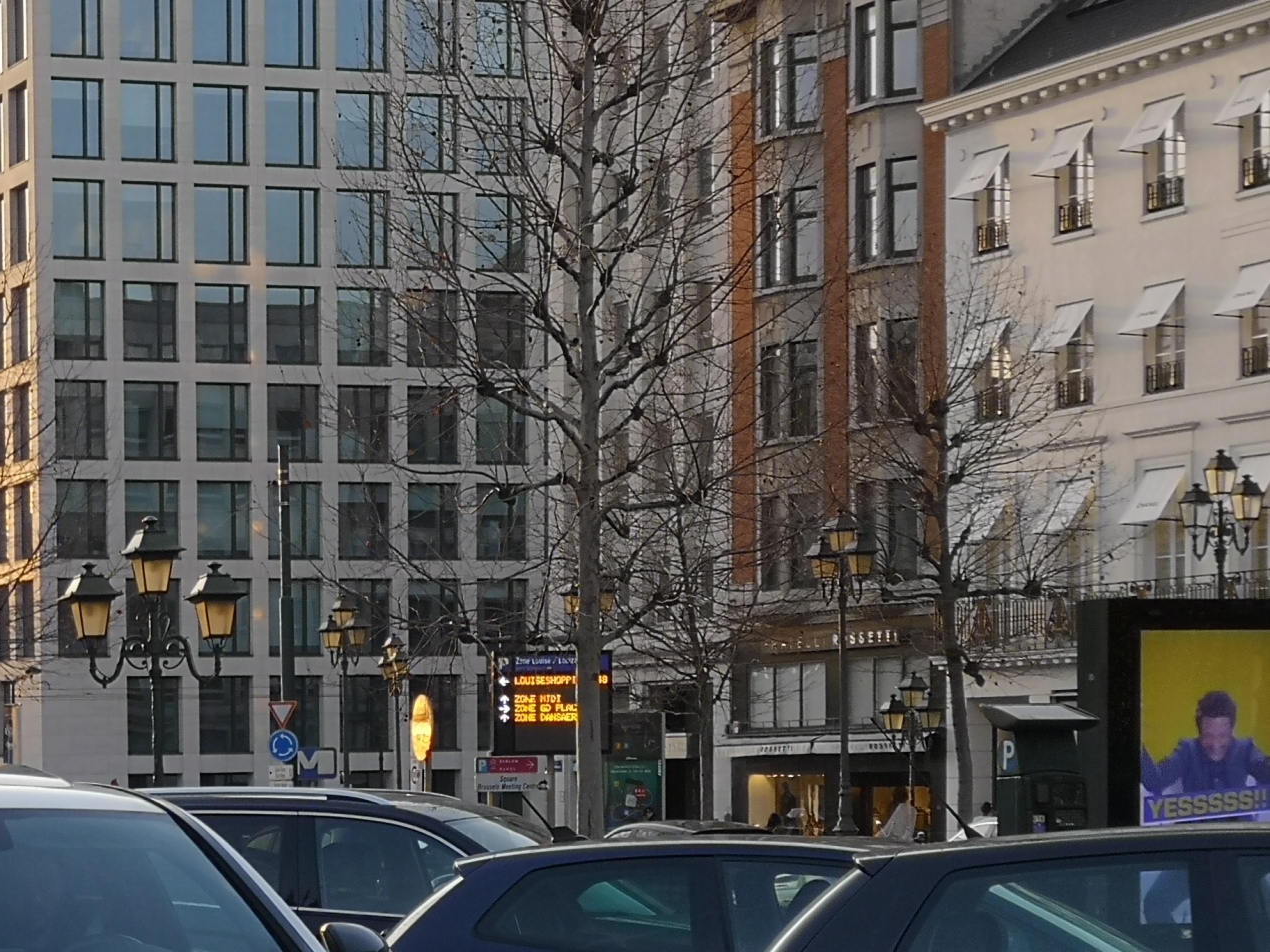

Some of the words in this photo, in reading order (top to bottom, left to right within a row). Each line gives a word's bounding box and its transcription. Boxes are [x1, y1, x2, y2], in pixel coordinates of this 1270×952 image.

[832, 629, 898, 647] RSSETTI
[514, 675, 578, 686] LOUISESHOPPI
[514, 694, 536, 704] ZONE
[514, 704, 536, 713] ZONE
[555, 704, 578, 712] PLAC
[514, 713, 536, 722] ZONE
[540, 713, 578, 722] DANSAER
[1003, 740, 1015, 770] P
